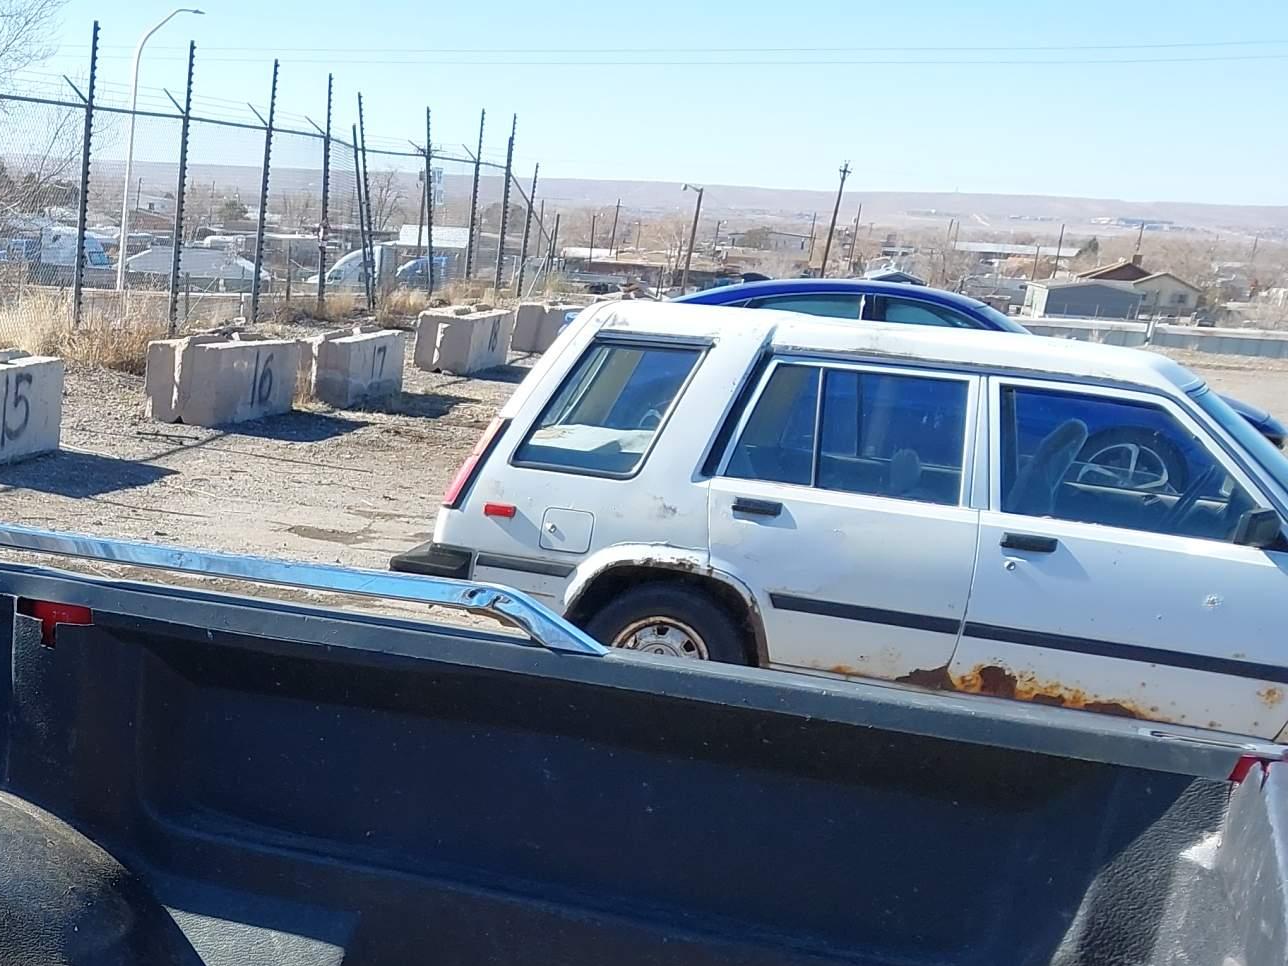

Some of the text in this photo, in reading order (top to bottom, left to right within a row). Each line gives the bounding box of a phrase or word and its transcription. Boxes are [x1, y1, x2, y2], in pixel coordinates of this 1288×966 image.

[250, 349, 275, 409] 16
[371, 345, 388, 379] 17
[0, 372, 33, 450] 15
